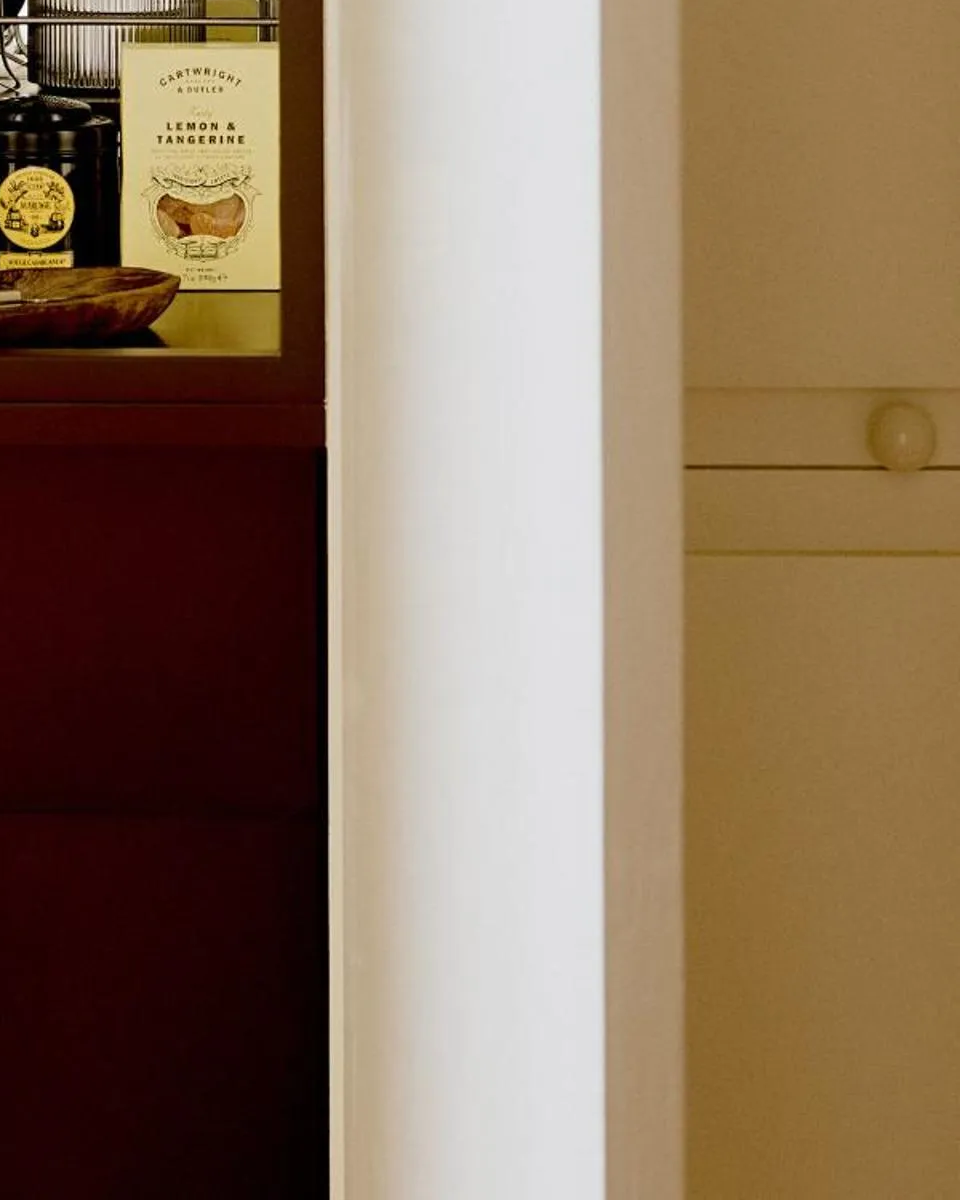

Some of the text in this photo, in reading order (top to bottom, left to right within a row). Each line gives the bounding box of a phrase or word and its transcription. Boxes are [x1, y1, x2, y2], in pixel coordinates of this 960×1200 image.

[159, 67, 242, 88] CARTWRIGHT
[166, 122, 236, 131] LEMON &
[157, 135, 245, 145] TANGERINE
